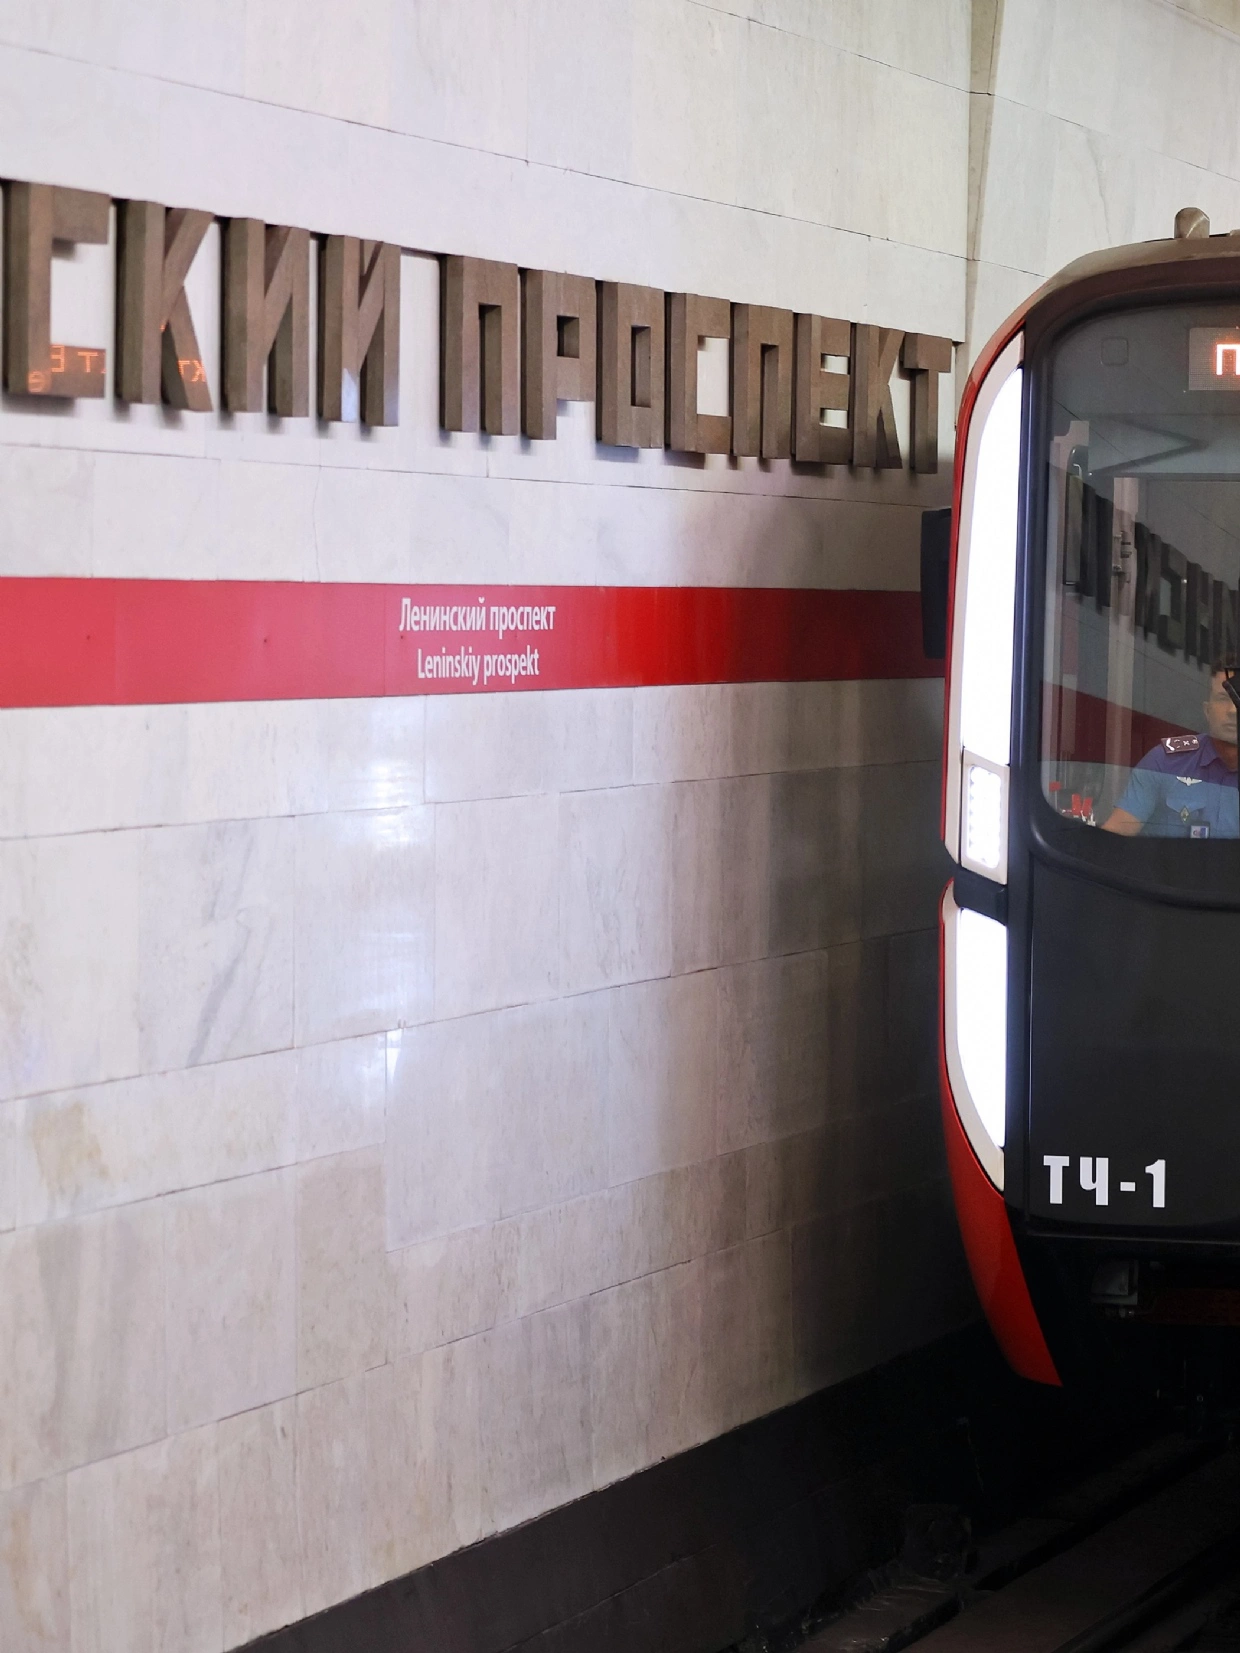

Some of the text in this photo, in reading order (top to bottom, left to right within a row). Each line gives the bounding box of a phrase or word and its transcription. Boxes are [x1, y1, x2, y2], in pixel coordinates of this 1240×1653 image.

[440, 254, 953, 474] ПРОСПЕКТ
[399, 597, 557, 640] Ленинский проспект
[417, 645, 540, 686] Leninskiy prospekt
[1043, 1155, 1166, 1208] ТЧ-1
